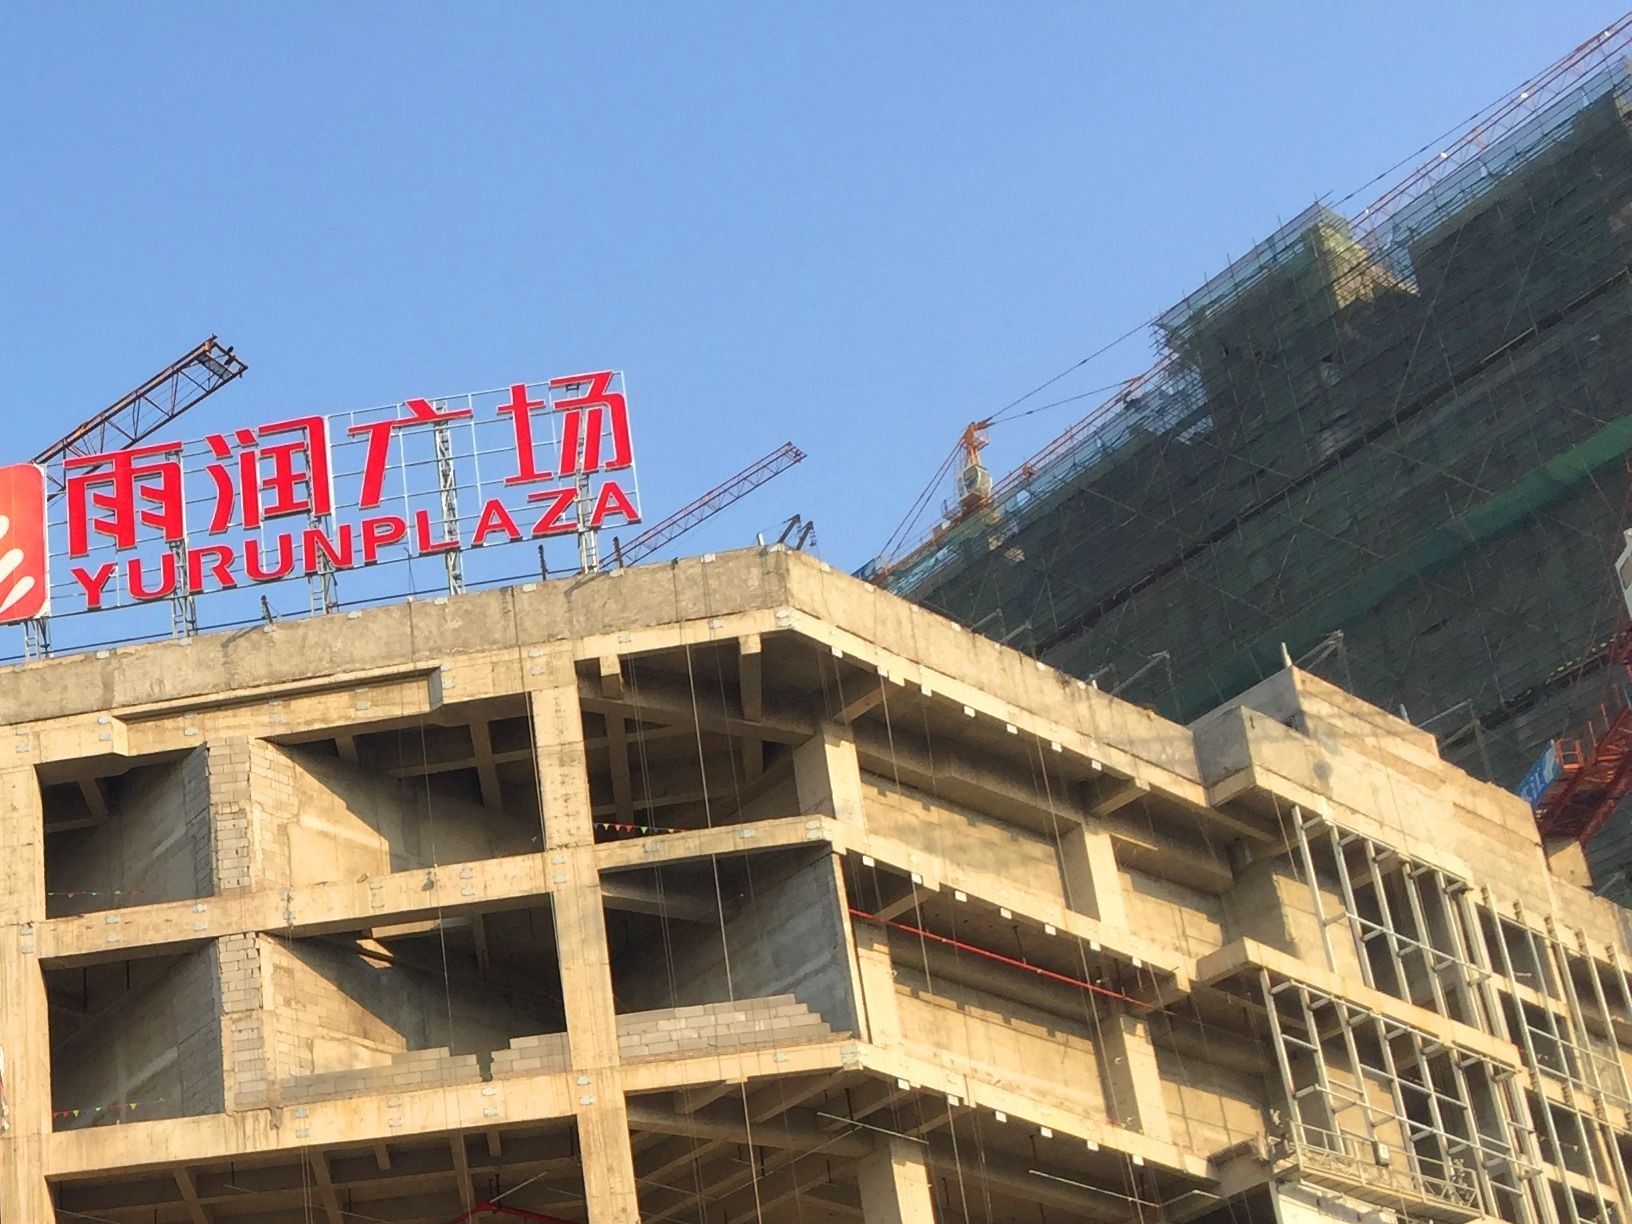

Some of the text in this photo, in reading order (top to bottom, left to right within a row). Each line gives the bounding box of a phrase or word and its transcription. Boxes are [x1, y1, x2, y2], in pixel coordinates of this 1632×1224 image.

[65, 369, 636, 560] 雨润广场
[71, 480, 642, 610] YURUNPLAZA
